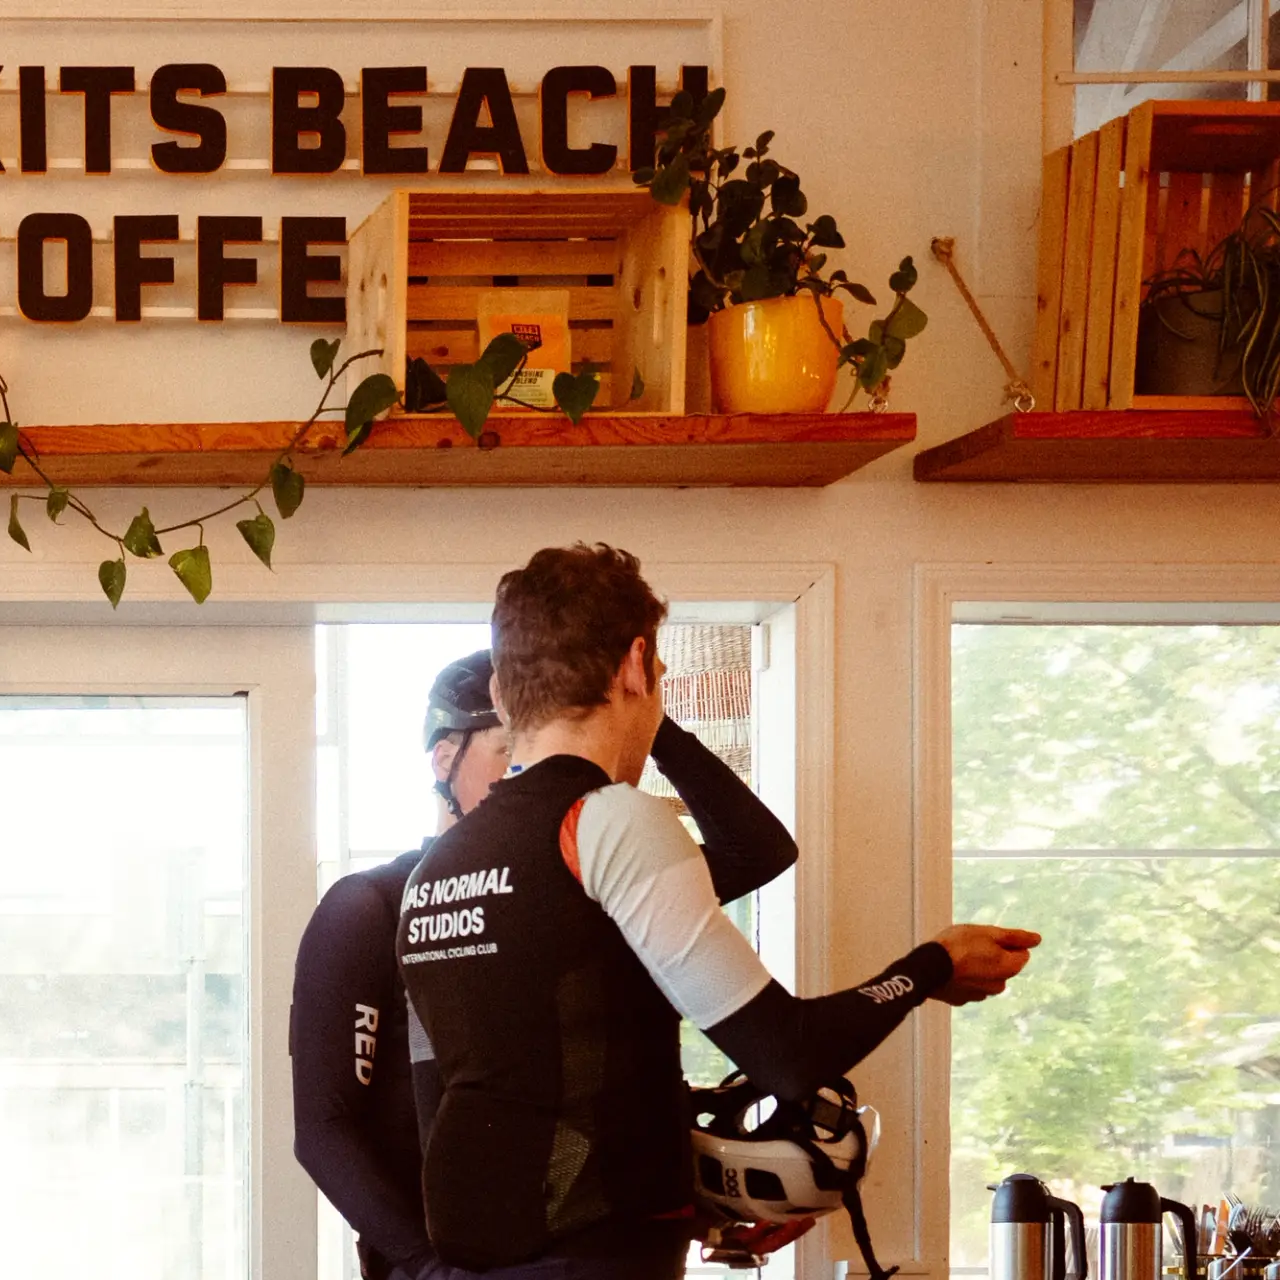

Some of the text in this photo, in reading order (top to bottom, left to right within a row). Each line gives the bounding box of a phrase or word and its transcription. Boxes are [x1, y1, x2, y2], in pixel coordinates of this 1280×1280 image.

[272, 64, 708, 176] BEACH
[430, 867, 513, 905] NORMAL
[408, 906, 485, 944] STUDIOS
[402, 942, 498, 965] INTERNATIONAL CYCLING CLUB
[355, 1003, 379, 1086] RED
